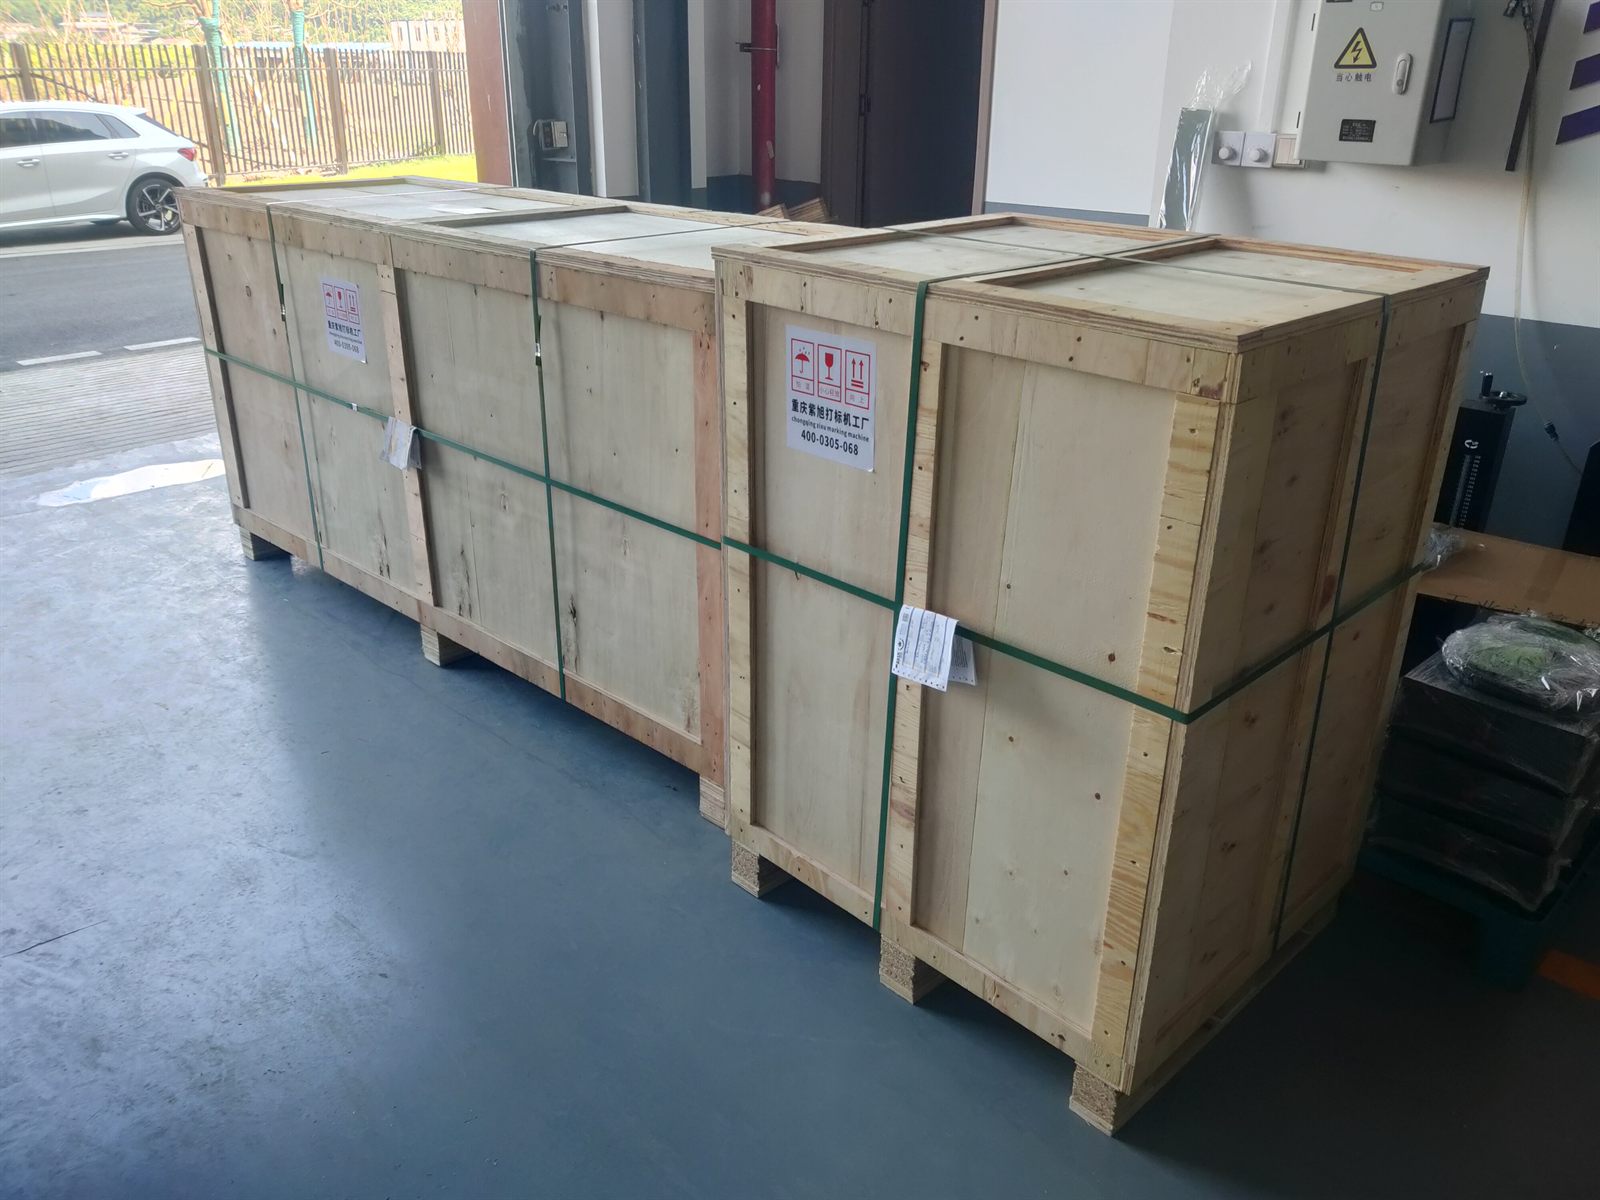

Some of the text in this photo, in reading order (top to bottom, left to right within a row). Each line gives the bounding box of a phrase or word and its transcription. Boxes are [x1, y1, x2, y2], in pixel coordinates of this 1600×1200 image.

[1336, 73, 1372, 82] 当心触电
[791, 399, 869, 430] 重庆紫旭打标机工厂
[791, 416, 816, 429] chongqing
[827, 425, 847, 437] marking
[848, 431, 869, 442] machine
[801, 429, 859, 456] 400-0305-068
